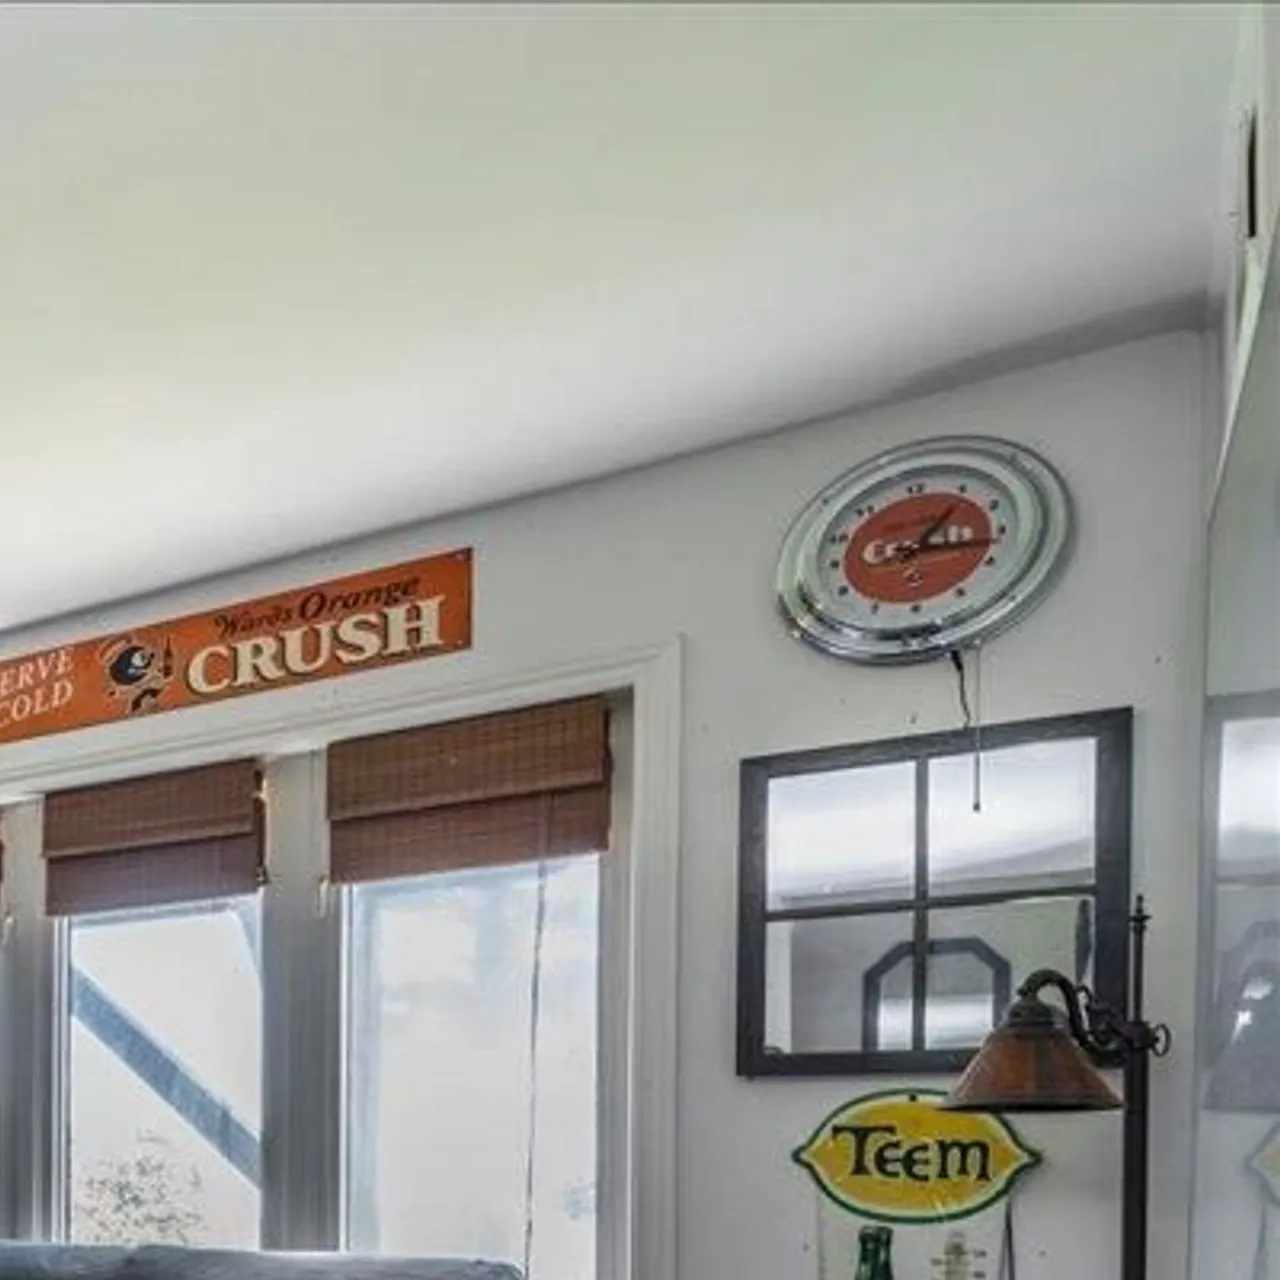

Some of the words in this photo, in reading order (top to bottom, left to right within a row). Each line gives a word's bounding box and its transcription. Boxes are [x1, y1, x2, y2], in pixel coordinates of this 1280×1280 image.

[298, 577, 422, 621] Orange
[185, 595, 446, 694] CRUSH
[831, 1125, 990, 1182] Teem
